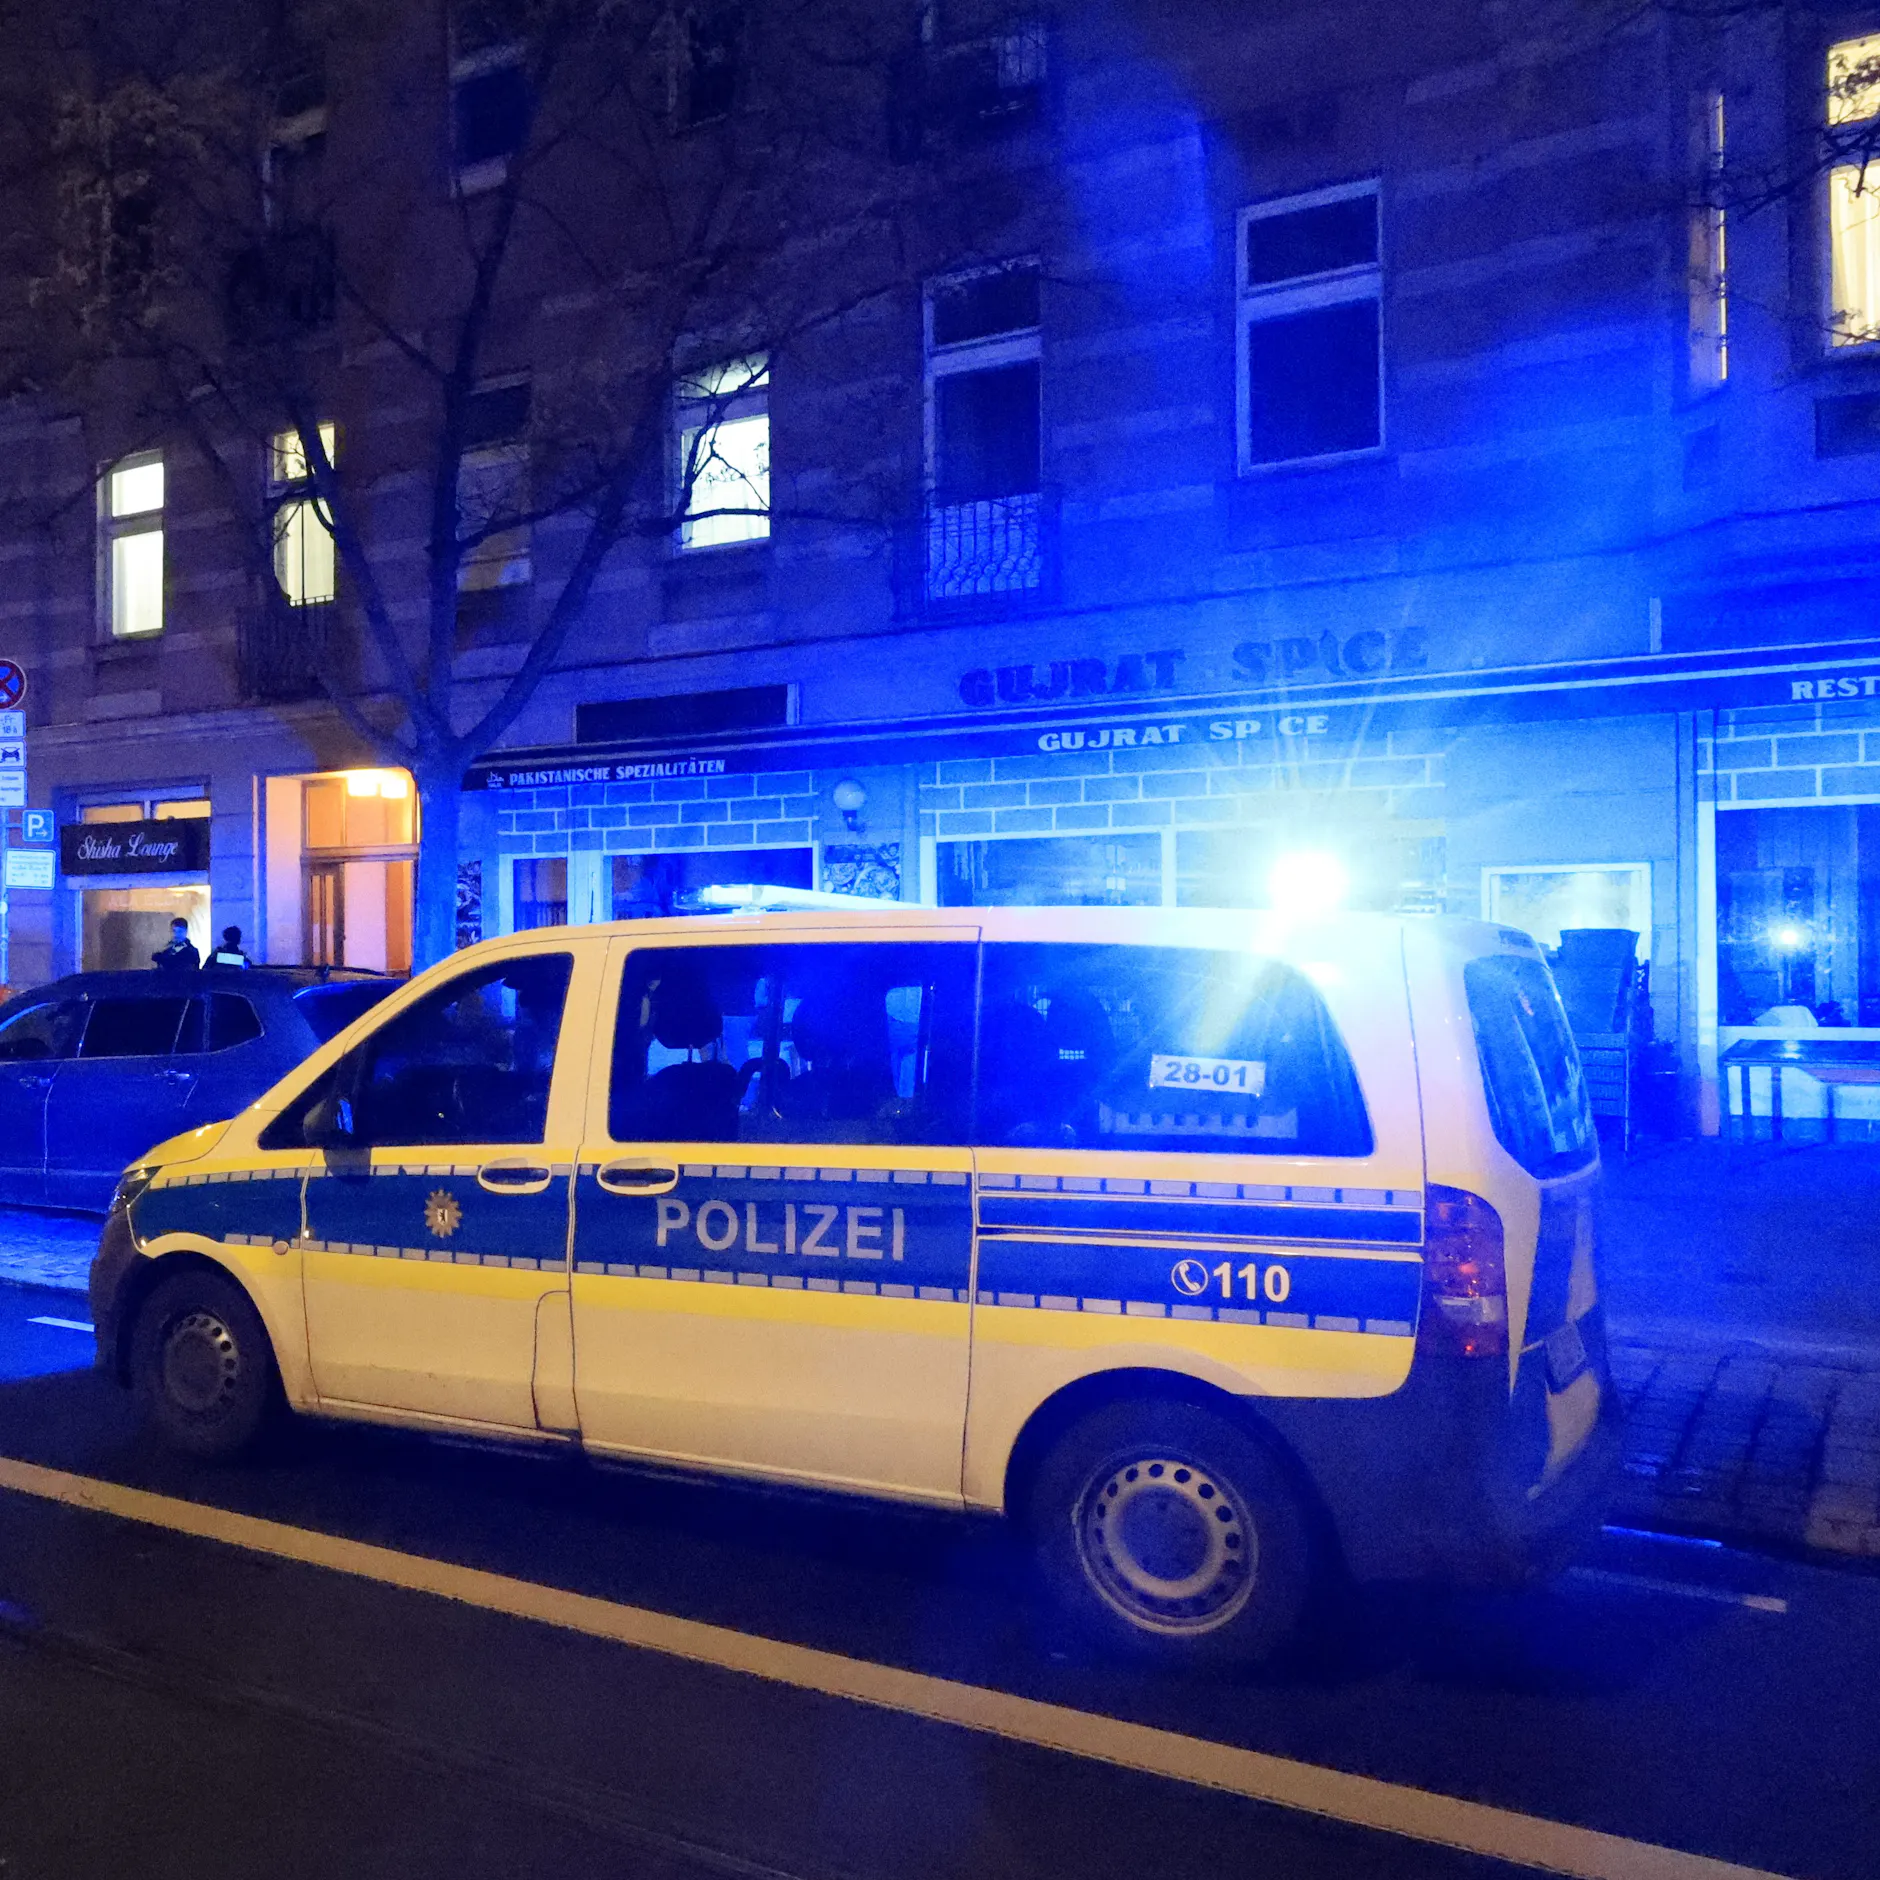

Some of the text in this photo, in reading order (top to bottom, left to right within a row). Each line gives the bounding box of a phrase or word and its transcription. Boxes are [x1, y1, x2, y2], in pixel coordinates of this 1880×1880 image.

[958, 649, 1187, 707] GUJRAT
[1791, 675, 1880, 700] REST
[1037, 715, 1329, 752] GUJRAT SPCE
[509, 766, 610, 786] PAKISTANISCHE
[616, 757, 726, 780] SPEZIALITÄTEN
[27, 814, 45, 837] P
[77, 832, 179, 863] Shisha Lounge
[1163, 1061, 1248, 1088] 28-01
[656, 1199, 905, 1261] POLIZEI
[1213, 1261, 1291, 1303] 110
